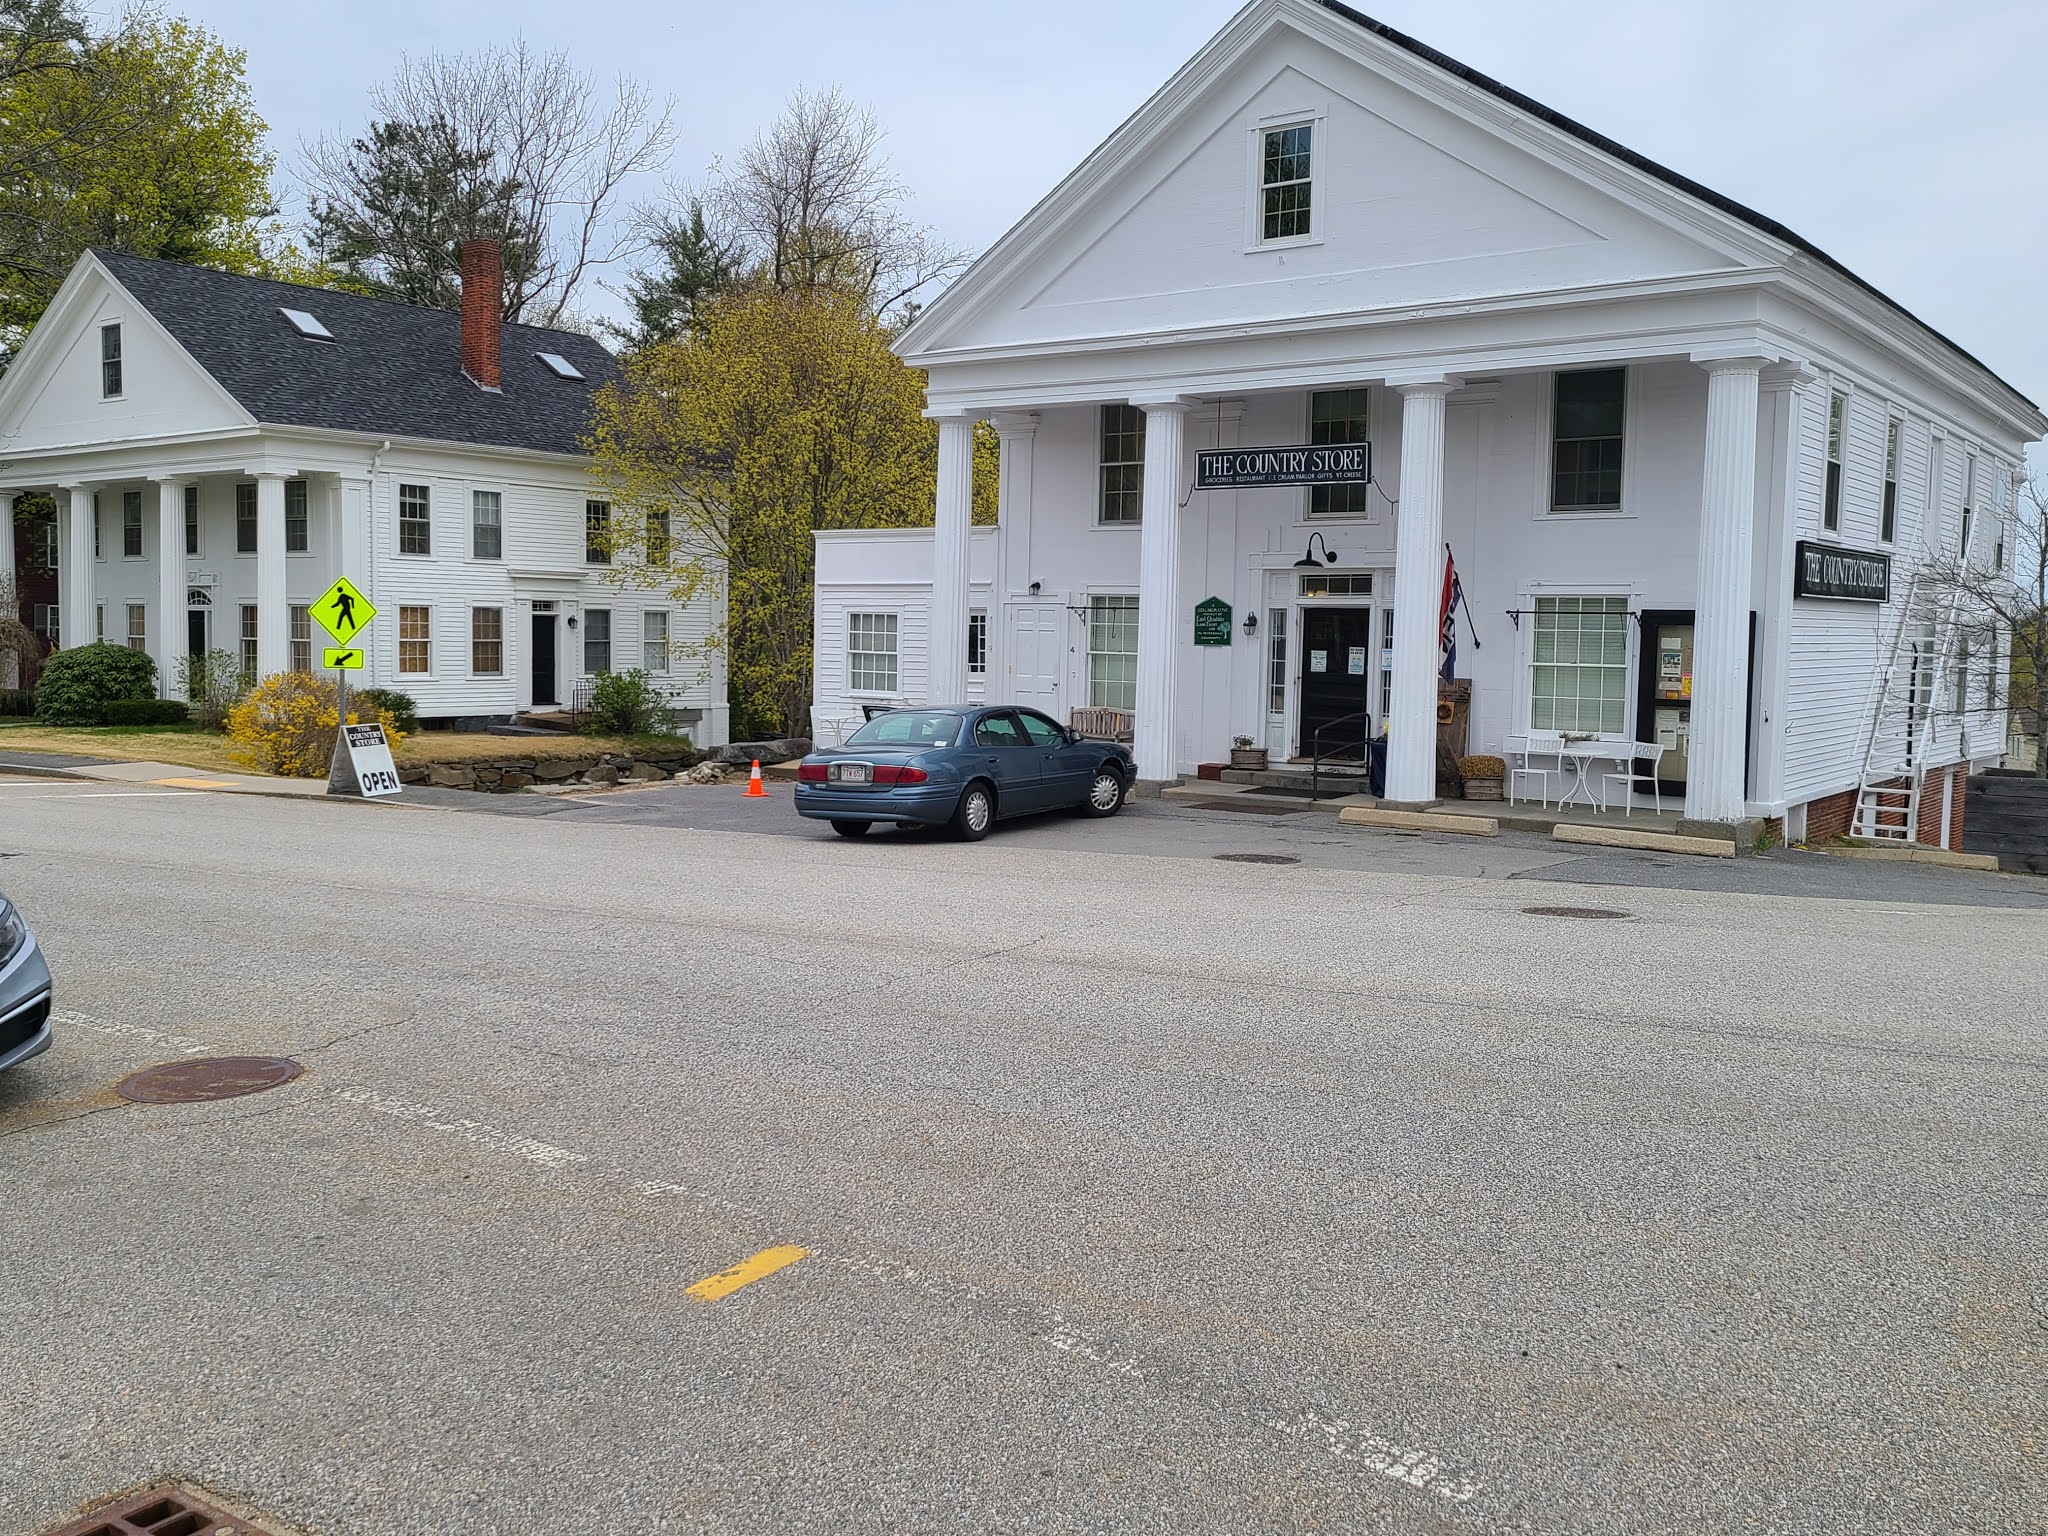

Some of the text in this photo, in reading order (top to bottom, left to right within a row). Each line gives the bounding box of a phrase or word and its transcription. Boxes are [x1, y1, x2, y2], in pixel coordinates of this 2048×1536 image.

[1203, 449, 1363, 476] THE COUNTRY STORE
[1805, 552, 1884, 588] THE COUNTRY STORE
[349, 731, 382, 740] COUNTRY
[355, 738, 381, 747] STORE
[362, 770, 398, 792] OPEN
